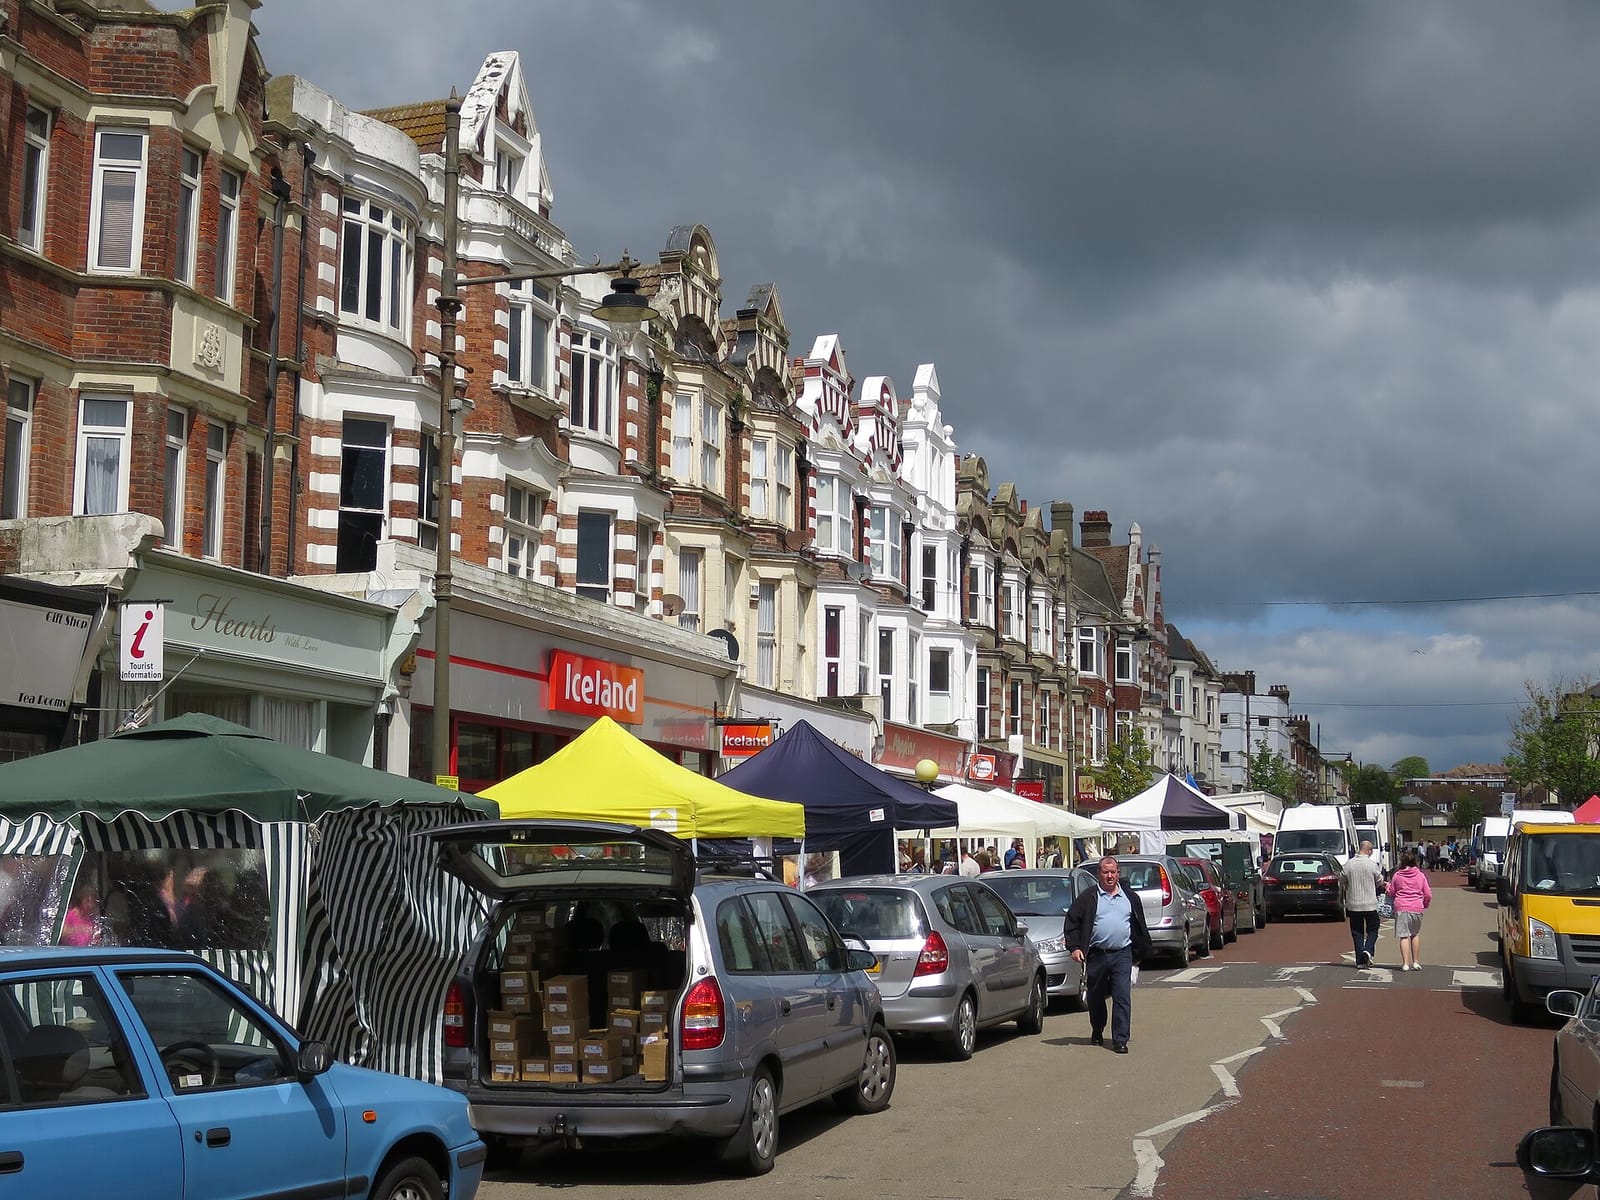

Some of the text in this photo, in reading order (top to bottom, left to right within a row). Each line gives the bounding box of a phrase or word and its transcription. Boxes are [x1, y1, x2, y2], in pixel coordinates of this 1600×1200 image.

[45, 611, 88, 629] Gift Shop
[191, 594, 277, 643] Hearts
[130, 662, 154, 670] Tourist
[121, 671, 161, 679] Information
[565, 663, 637, 713] Iceland
[18, 692, 67, 708] Tea Rooms
[724, 734, 769, 747] Iceland
